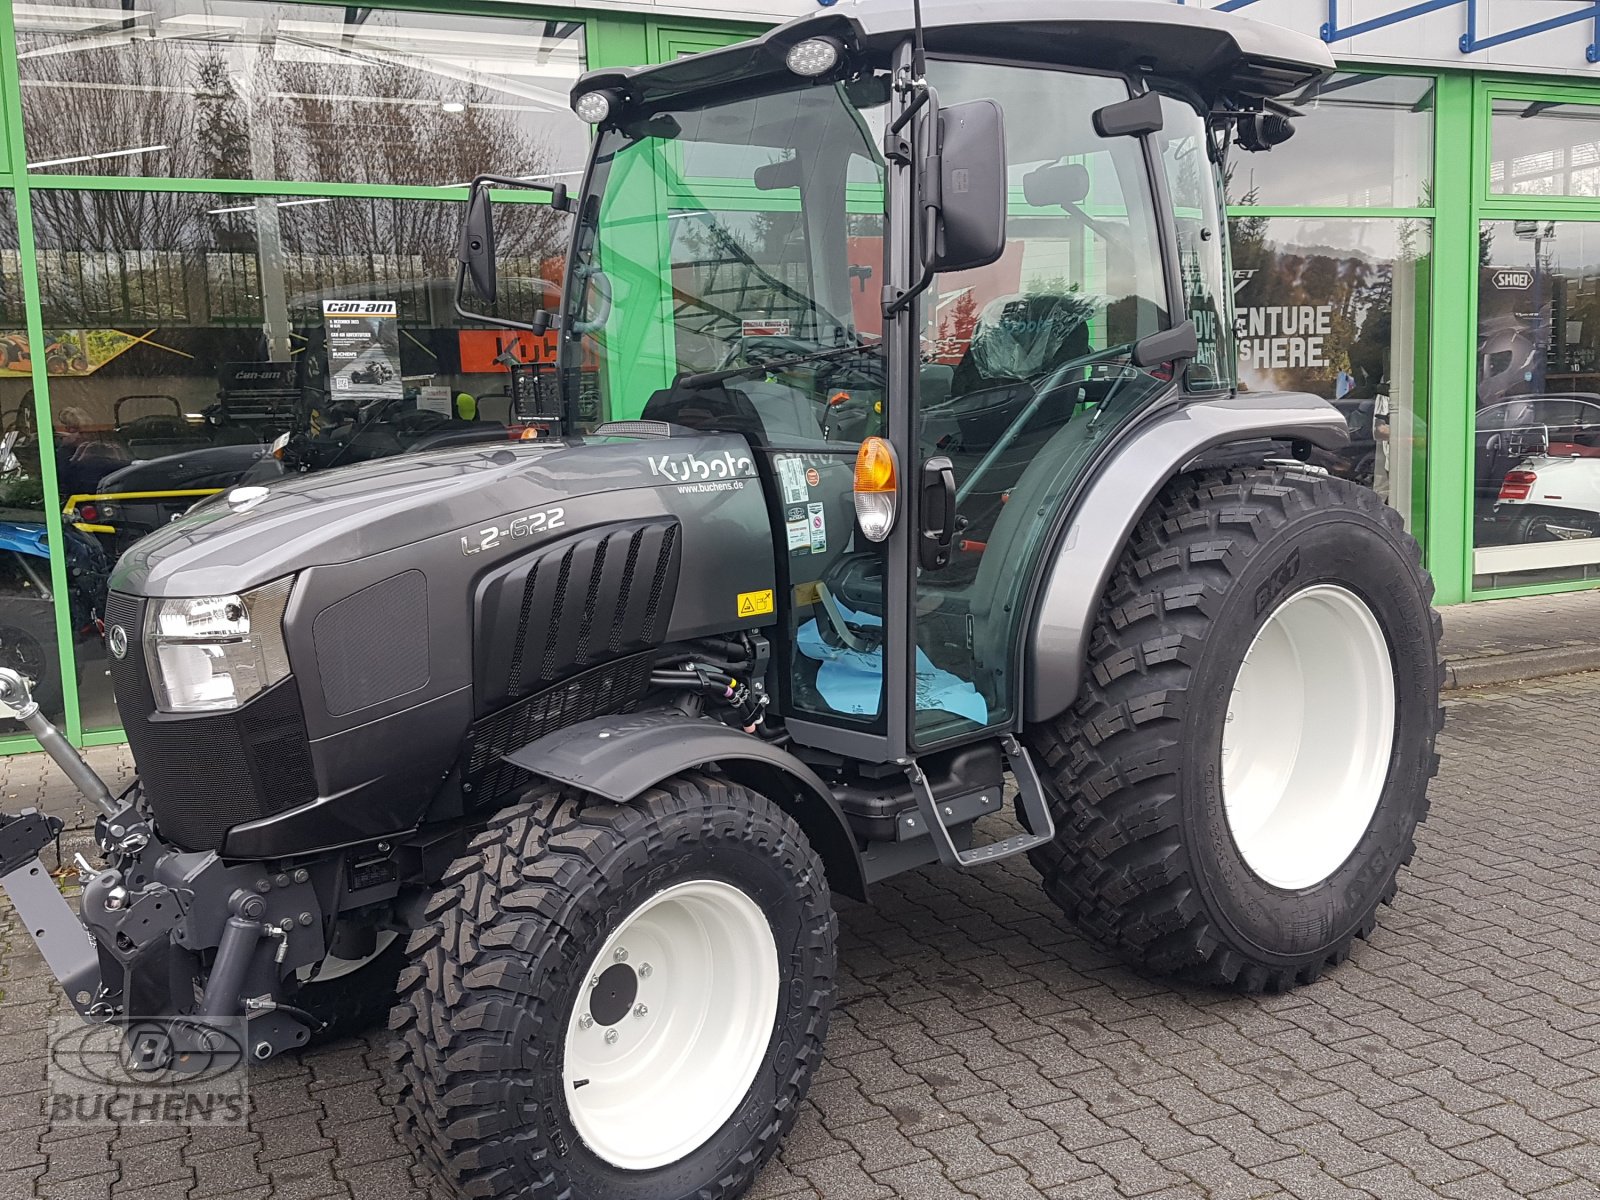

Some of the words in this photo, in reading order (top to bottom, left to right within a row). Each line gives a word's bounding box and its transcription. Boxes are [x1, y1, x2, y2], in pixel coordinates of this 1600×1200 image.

[1498, 273, 1528, 287] SHOEI
[326, 302, 394, 313] can-am
[1253, 336, 1330, 369] HERE.
[647, 451, 756, 482] Kubota
[677, 480, 744, 494] www.buchens.de
[460, 507, 566, 557] L2-622
[1254, 545, 1300, 620] BKT
[772, 945, 806, 1076] TOYO
